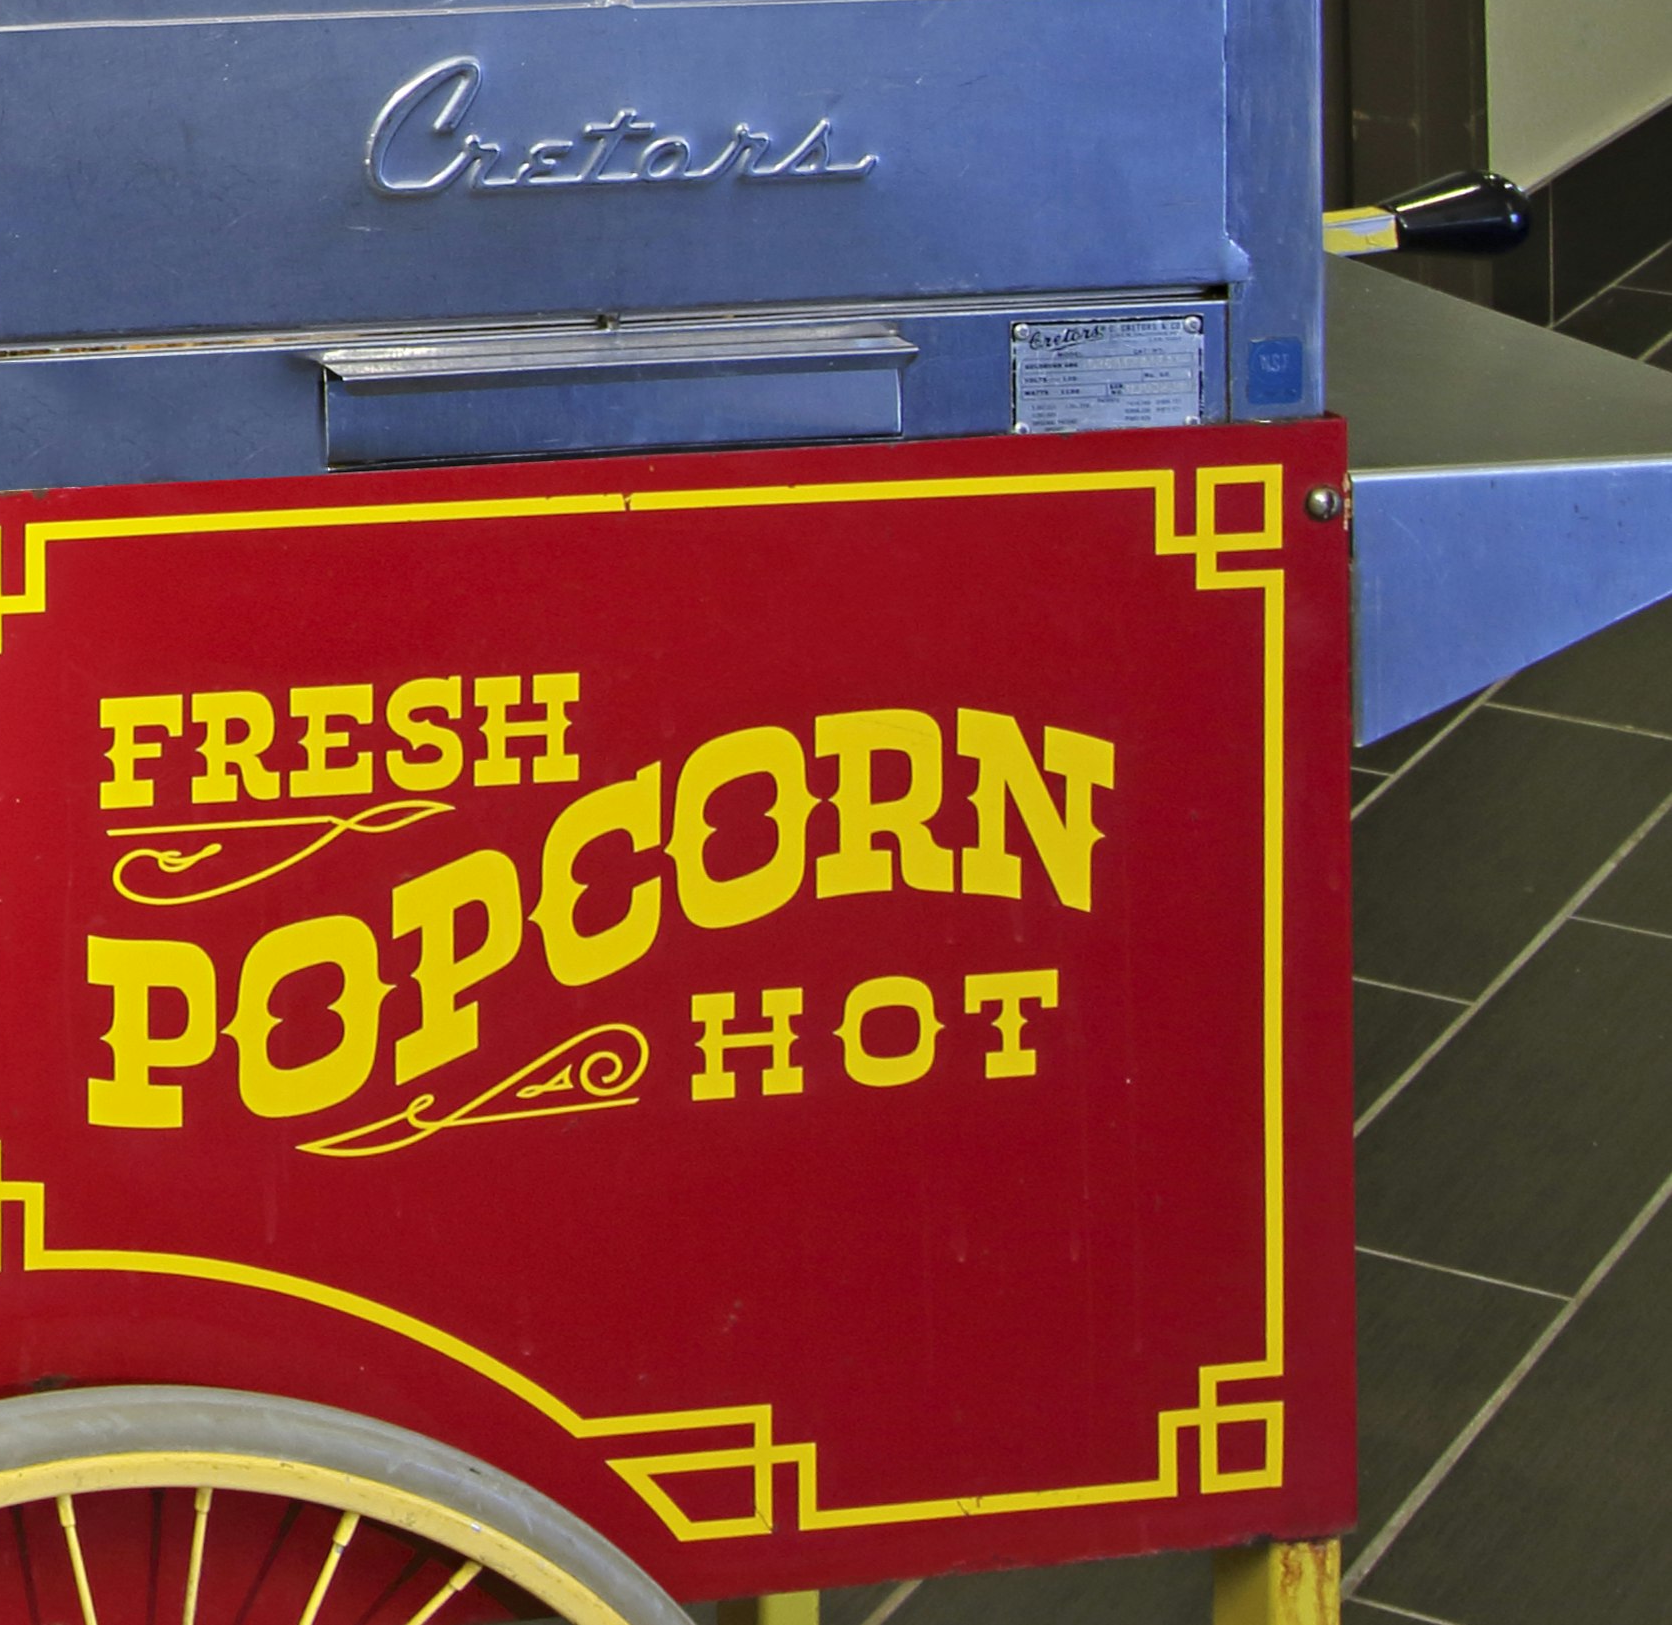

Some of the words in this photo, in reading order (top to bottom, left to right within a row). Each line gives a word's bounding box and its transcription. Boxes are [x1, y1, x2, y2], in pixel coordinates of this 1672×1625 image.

[363, 54, 880, 197] Cretors
[99, 672, 580, 810] FRESH
[87, 706, 1115, 1130] POPCORN
[690, 969, 1059, 1102] HOT
